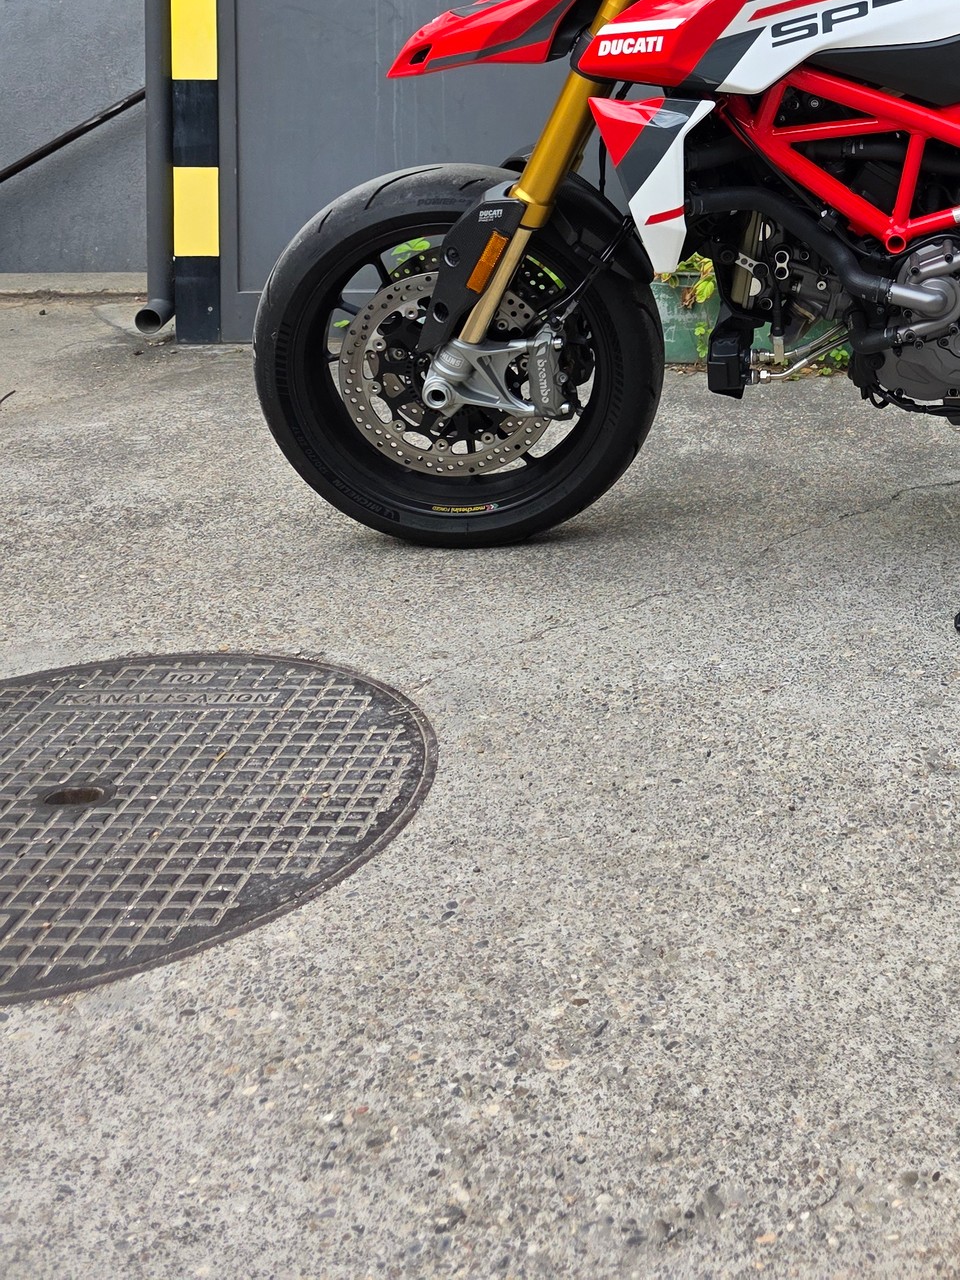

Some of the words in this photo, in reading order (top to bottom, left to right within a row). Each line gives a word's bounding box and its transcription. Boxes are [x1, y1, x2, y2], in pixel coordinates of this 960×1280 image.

[771, 0, 869, 48] SP
[598, 36, 663, 57] DUCATI
[479, 209, 503, 217] DUCATI
[537, 359, 551, 404] brembo
[332, 478, 384, 513] MICHELIN
[65, 692, 272, 705] KANALISATION
